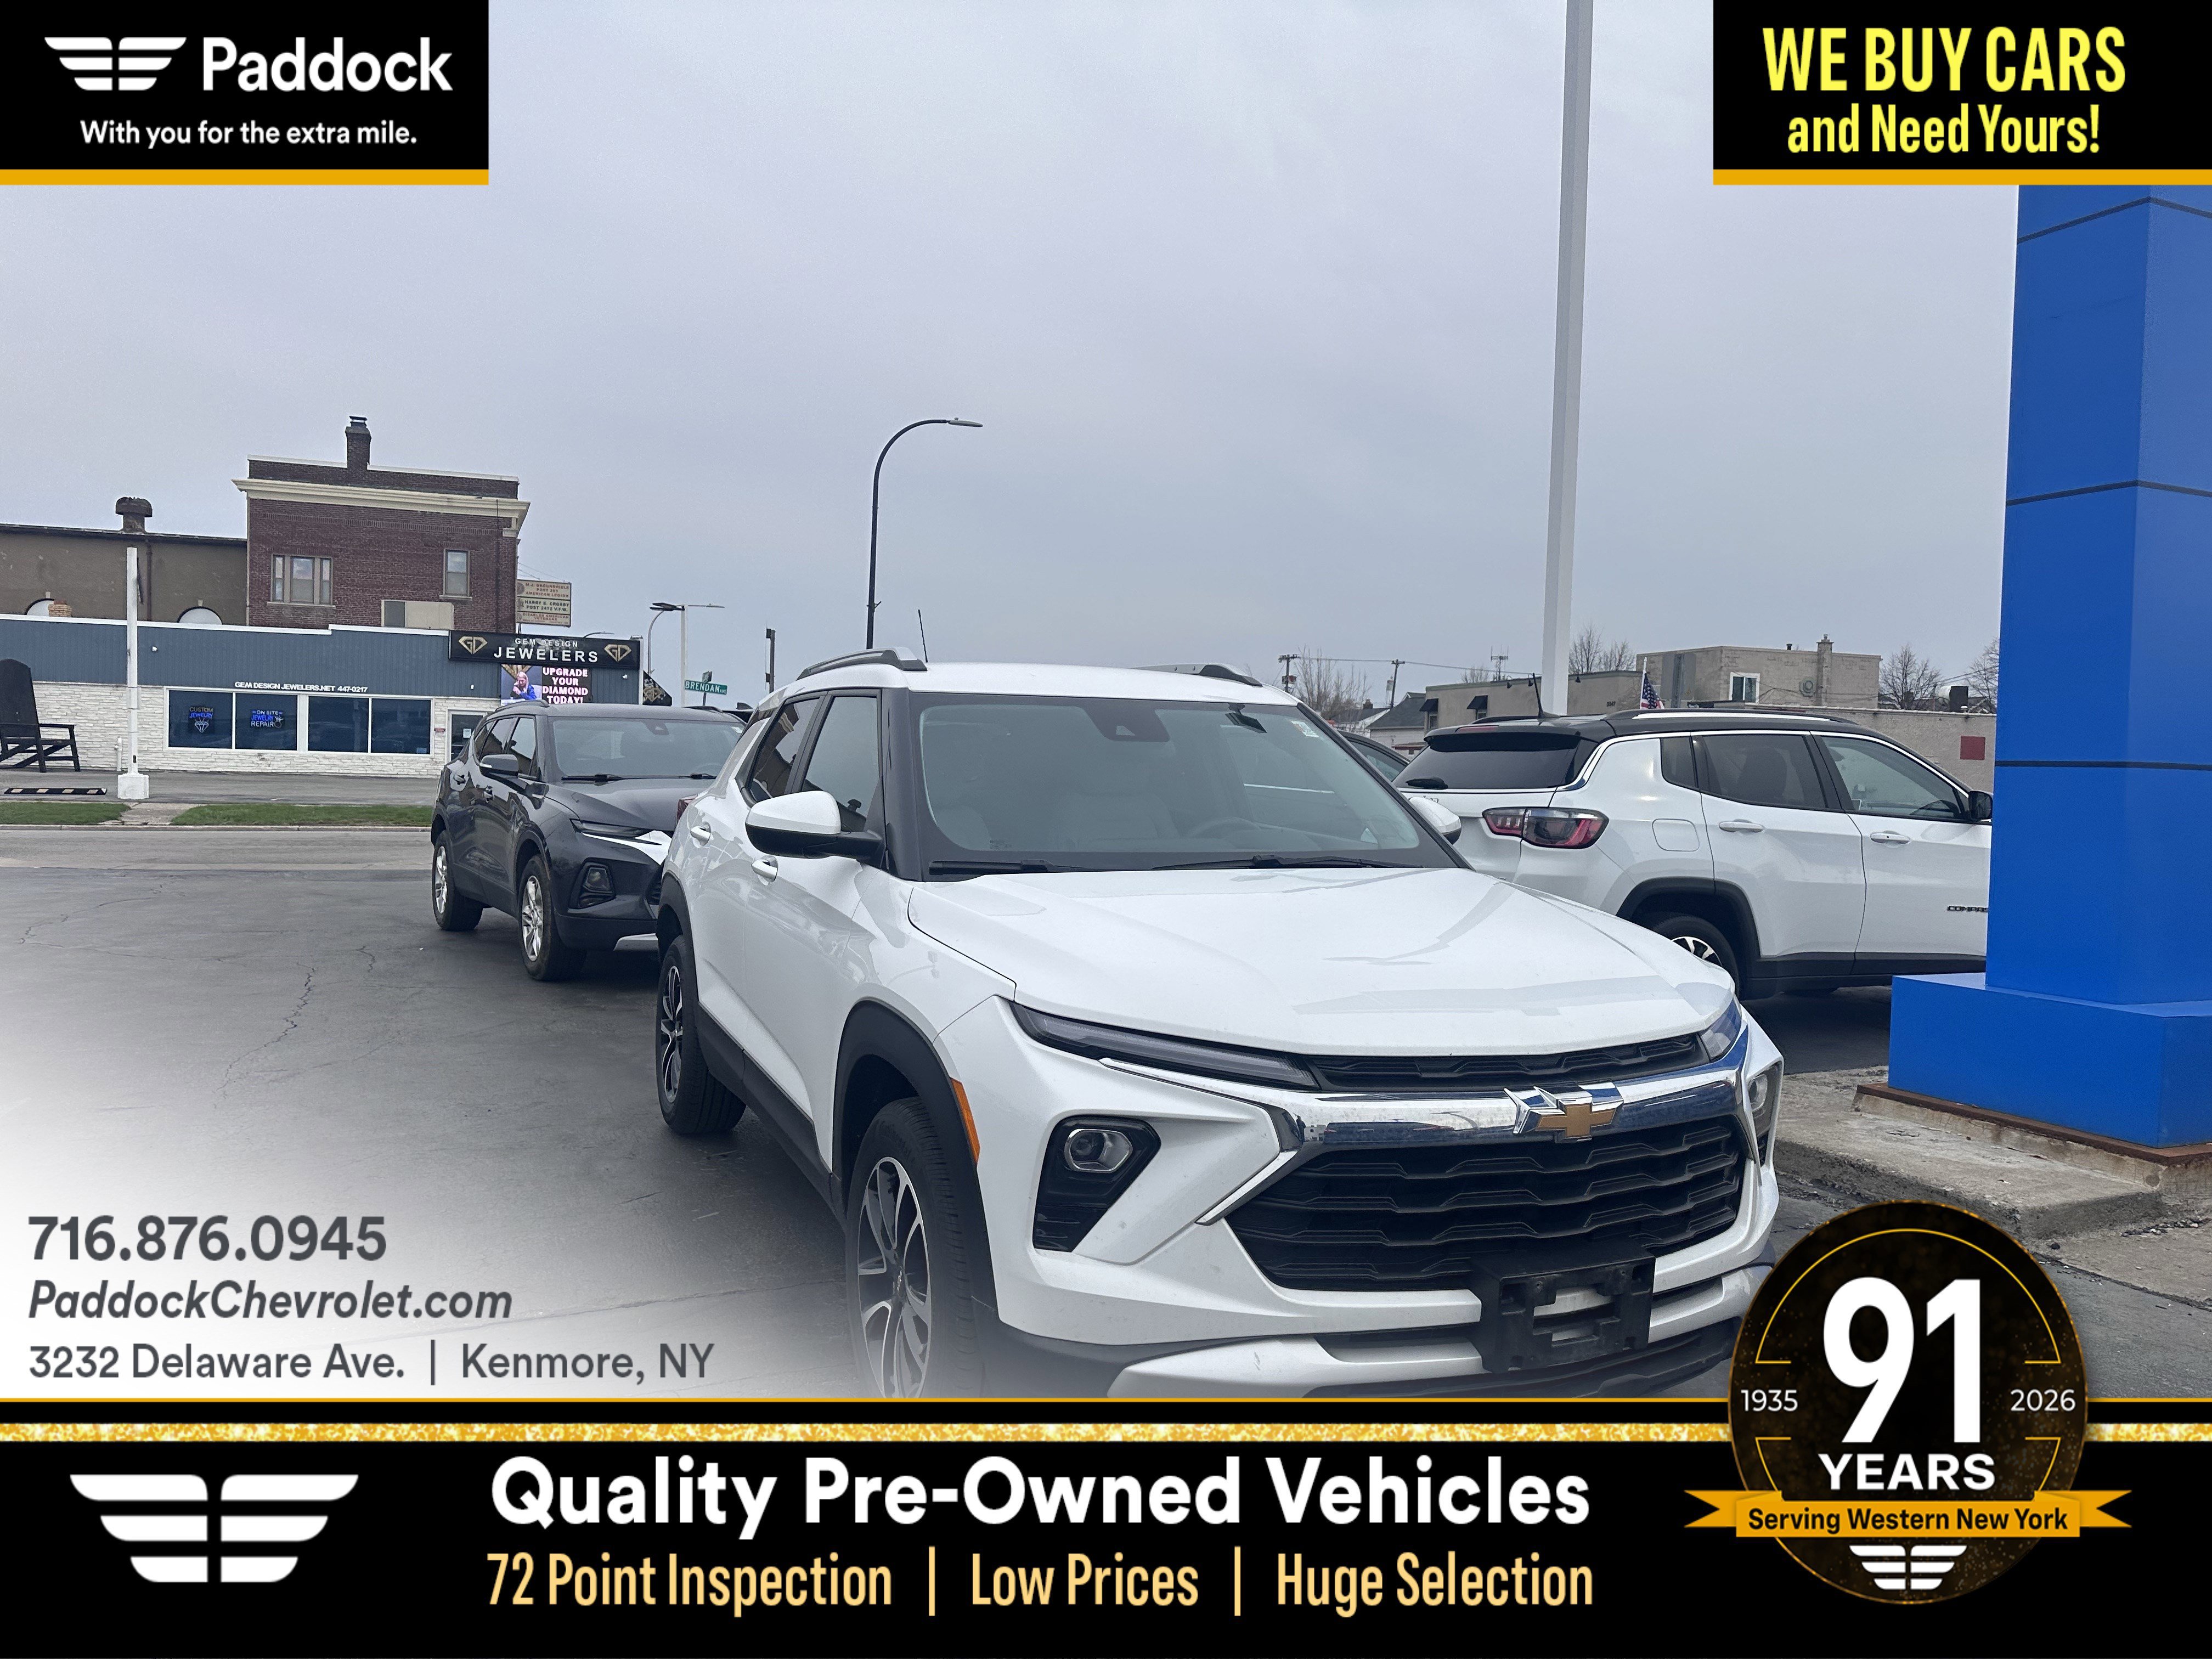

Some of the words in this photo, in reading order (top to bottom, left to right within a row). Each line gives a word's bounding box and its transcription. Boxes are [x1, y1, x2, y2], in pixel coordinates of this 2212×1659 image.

[541, 639, 578, 647] DESIGN
[494, 647, 598, 663] JEWELERS
[543, 667, 588, 677] UPGRADE
[551, 677, 579, 686] YOUR
[542, 686, 589, 695] DIAMOND
[685, 681, 720, 693] BRENDAN
[547, 696, 583, 704] TODAY!
